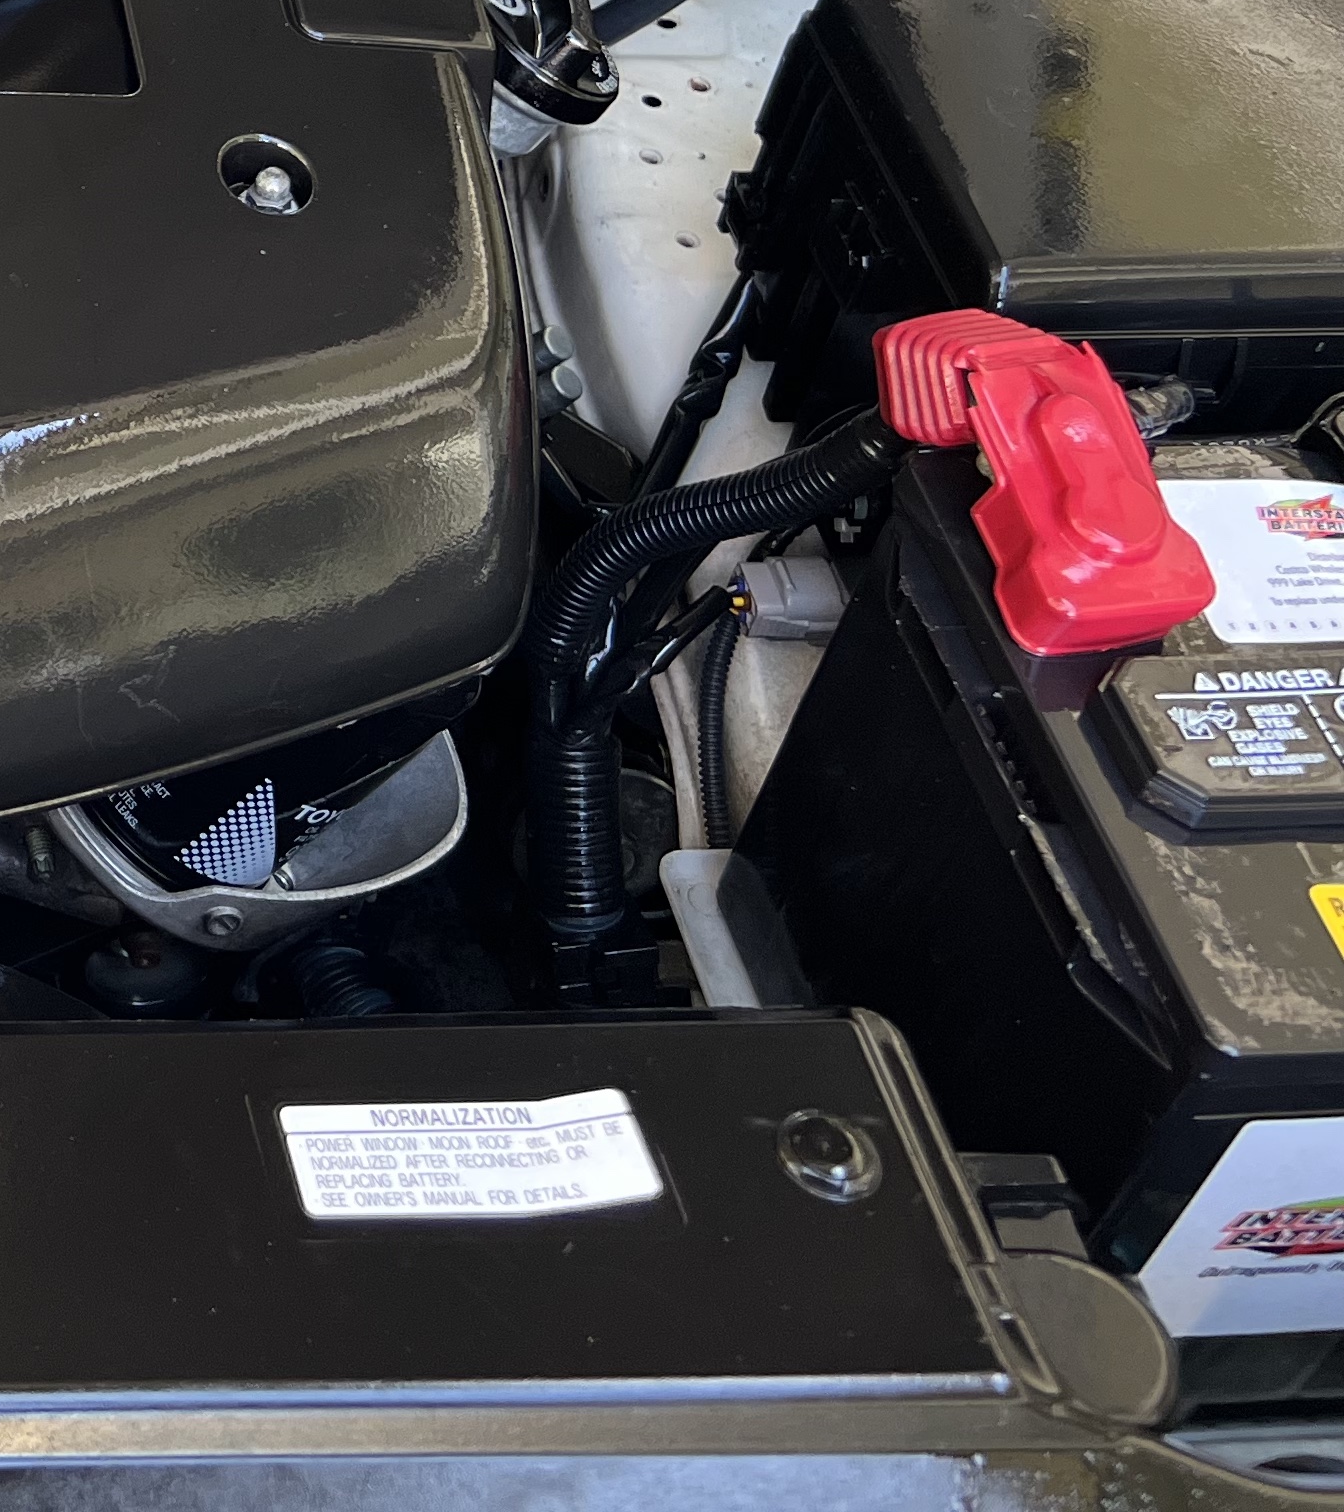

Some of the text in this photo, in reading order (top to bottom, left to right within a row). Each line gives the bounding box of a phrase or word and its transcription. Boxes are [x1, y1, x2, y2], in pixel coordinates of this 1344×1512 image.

[1217, 668, 1336, 691] DANGER
[1246, 703, 1300, 717] SHIELD
[1252, 717, 1294, 729] EYES
[1227, 728, 1309, 742] EXPLOSIVE
[370, 1106, 533, 1127] NORMALIZATION
[305, 1137, 355, 1153] POWER
[361, 1136, 417, 1152] WINDOW
[428, 1135, 472, 1151] MOON
[476, 1135, 513, 1150] ROOF
[555, 1124, 595, 1144] MUST
[602, 1121, 624, 1137] BE
[310, 1144, 589, 1170] NORMALIZED AFTER RECONNECTING OR
[315, 1172, 393, 1189] REPLACING
[321, 1192, 348, 1208] SEE
[354, 1191, 418, 1207] OWNER'S
[423, 1190, 484, 1206] MANUAL
[487, 1189, 519, 1206] FOR
